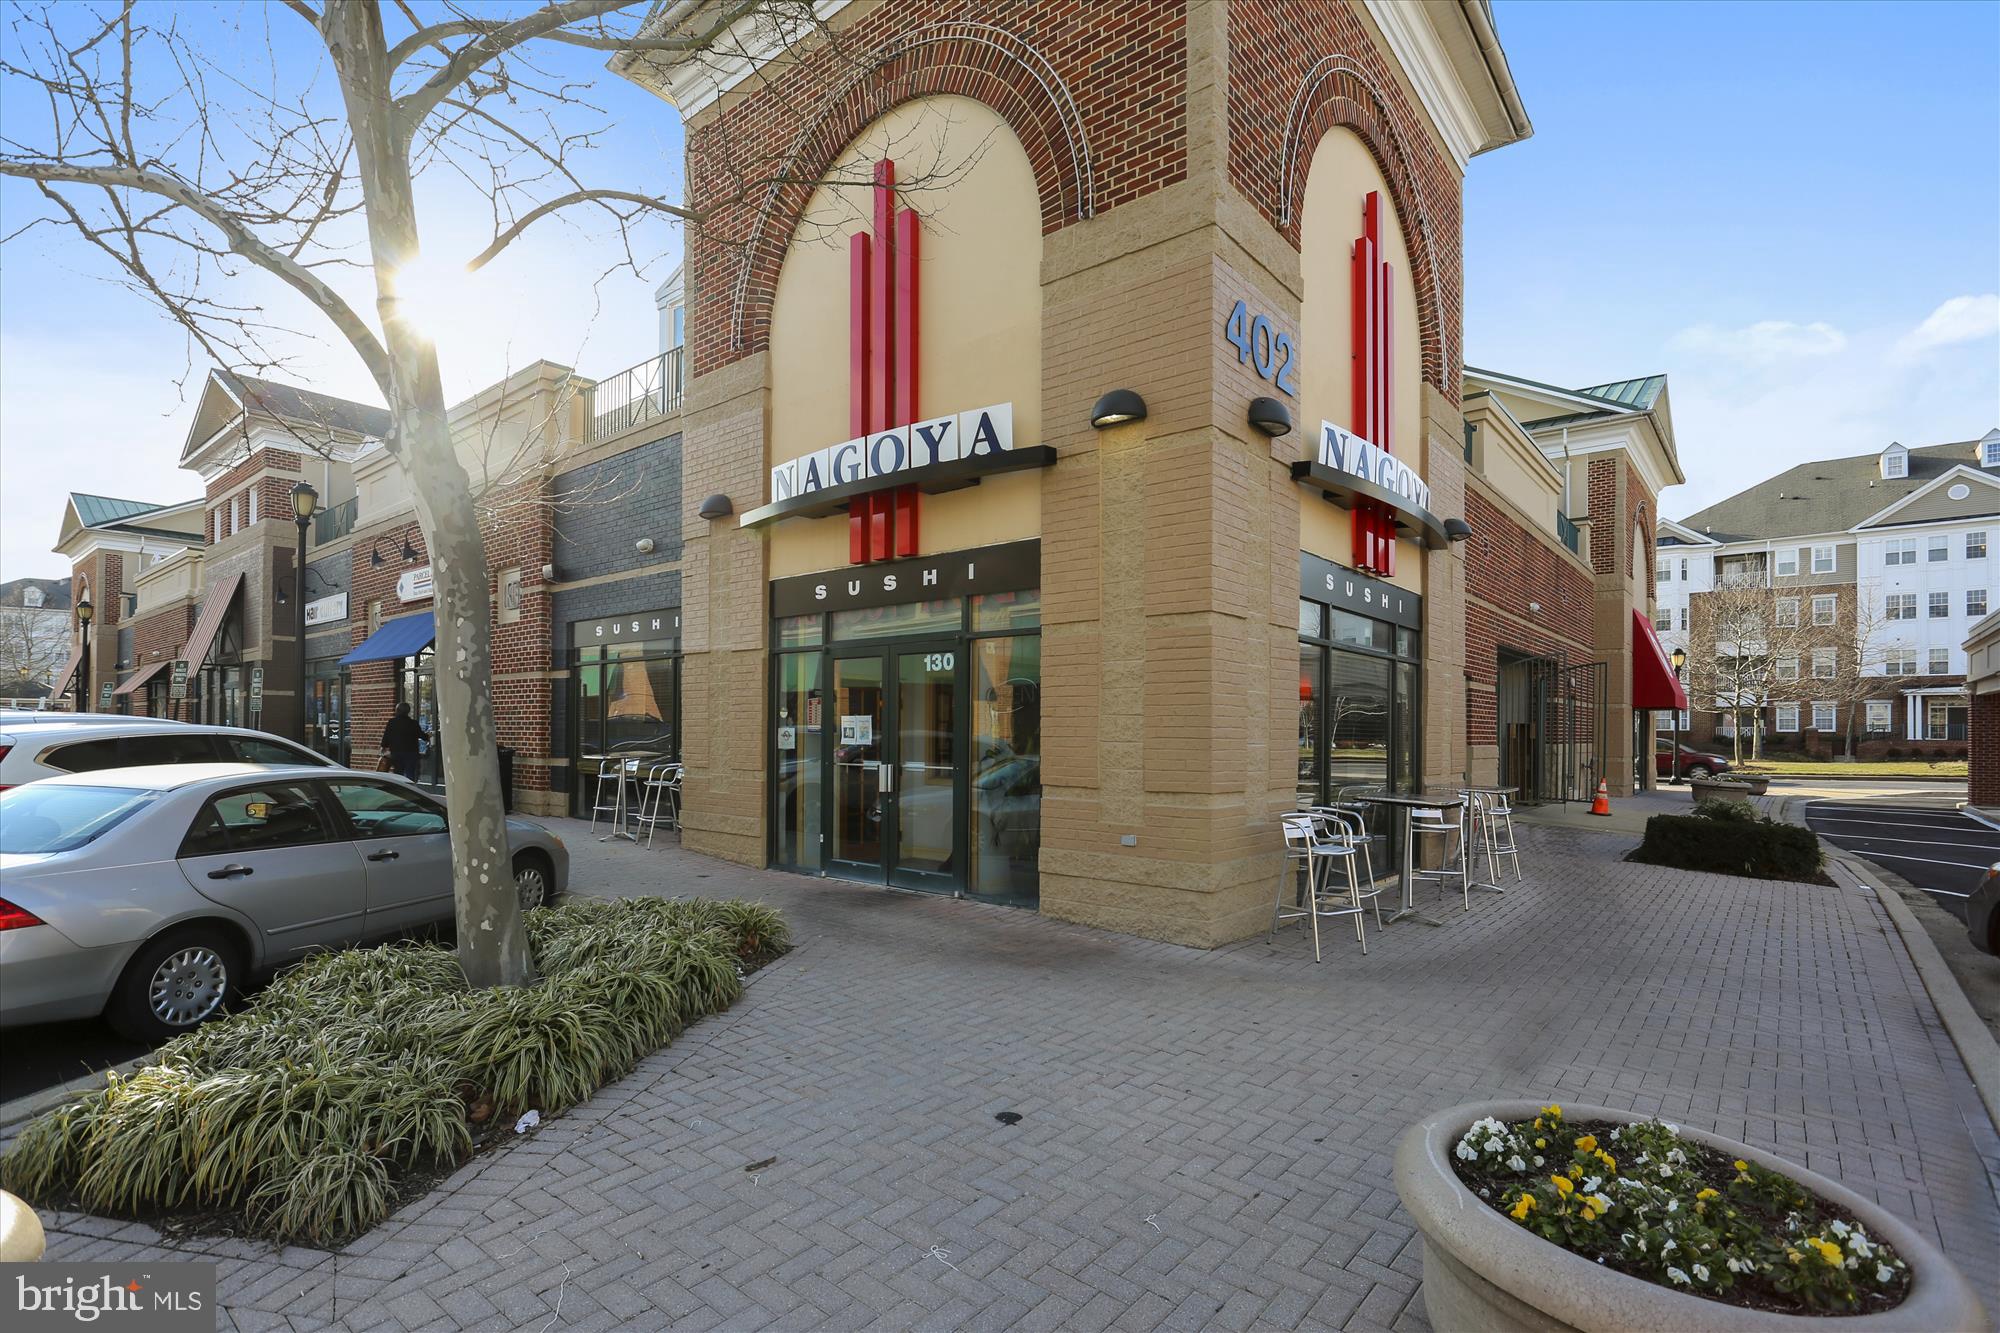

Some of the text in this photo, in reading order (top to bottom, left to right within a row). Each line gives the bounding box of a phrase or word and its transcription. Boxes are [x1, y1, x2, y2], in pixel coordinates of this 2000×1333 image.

[1226, 299, 1295, 396] 402
[774, 411, 1006, 502] NAGOYA
[815, 563, 976, 600] SUSHI
[1326, 573, 1403, 614] SUSHI
[595, 616, 679, 637] SUSHI
[923, 653, 955, 672] 130
